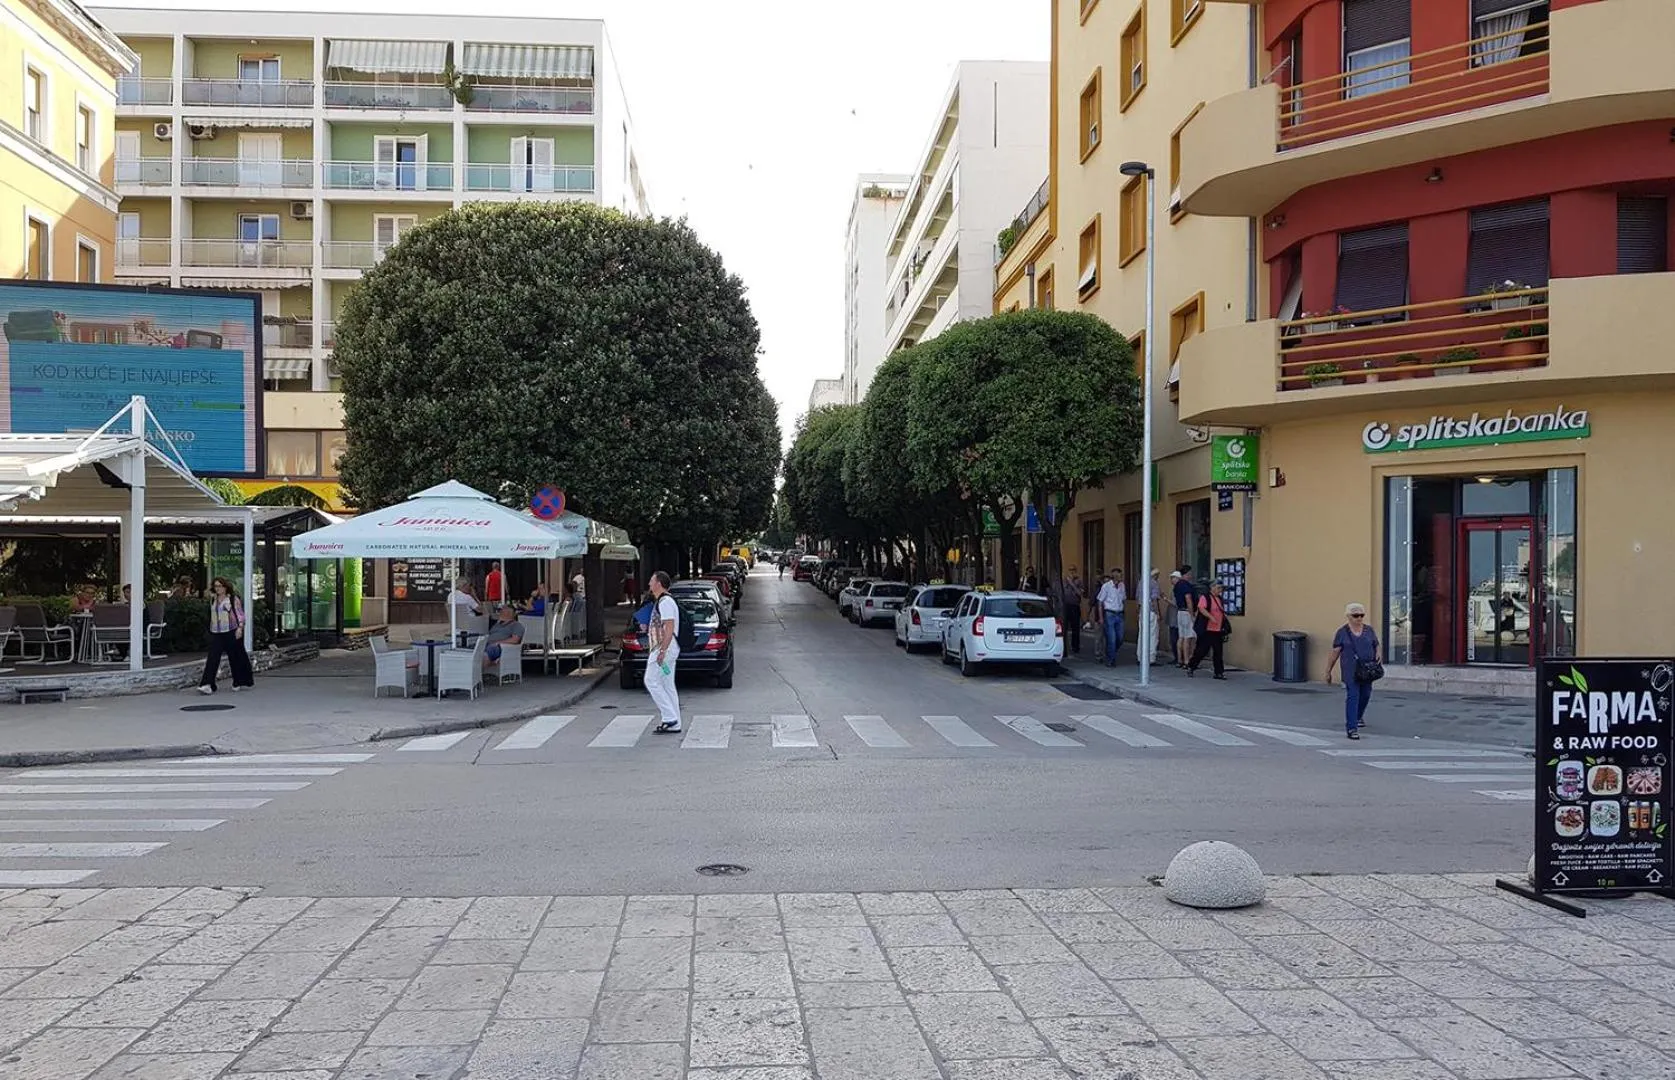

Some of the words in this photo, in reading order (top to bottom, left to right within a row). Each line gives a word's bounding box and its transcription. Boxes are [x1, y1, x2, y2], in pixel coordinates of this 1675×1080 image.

[32, 363, 69, 379] KOD
[75, 363, 117, 381] KUĆE
[122, 367, 138, 383] JE
[1396, 404, 1588, 449] splitskabanka
[1221, 460, 1251, 470] splitska
[1225, 470, 1247, 478] banka
[377, 516, 491, 528] Jamnica
[303, 541, 344, 551] Jamnica
[510, 542, 551, 552] Jamnica
[1552, 736, 1564, 750] &
[1568, 736, 1607, 750] RAW
[1611, 735, 1658, 749] FOOD
